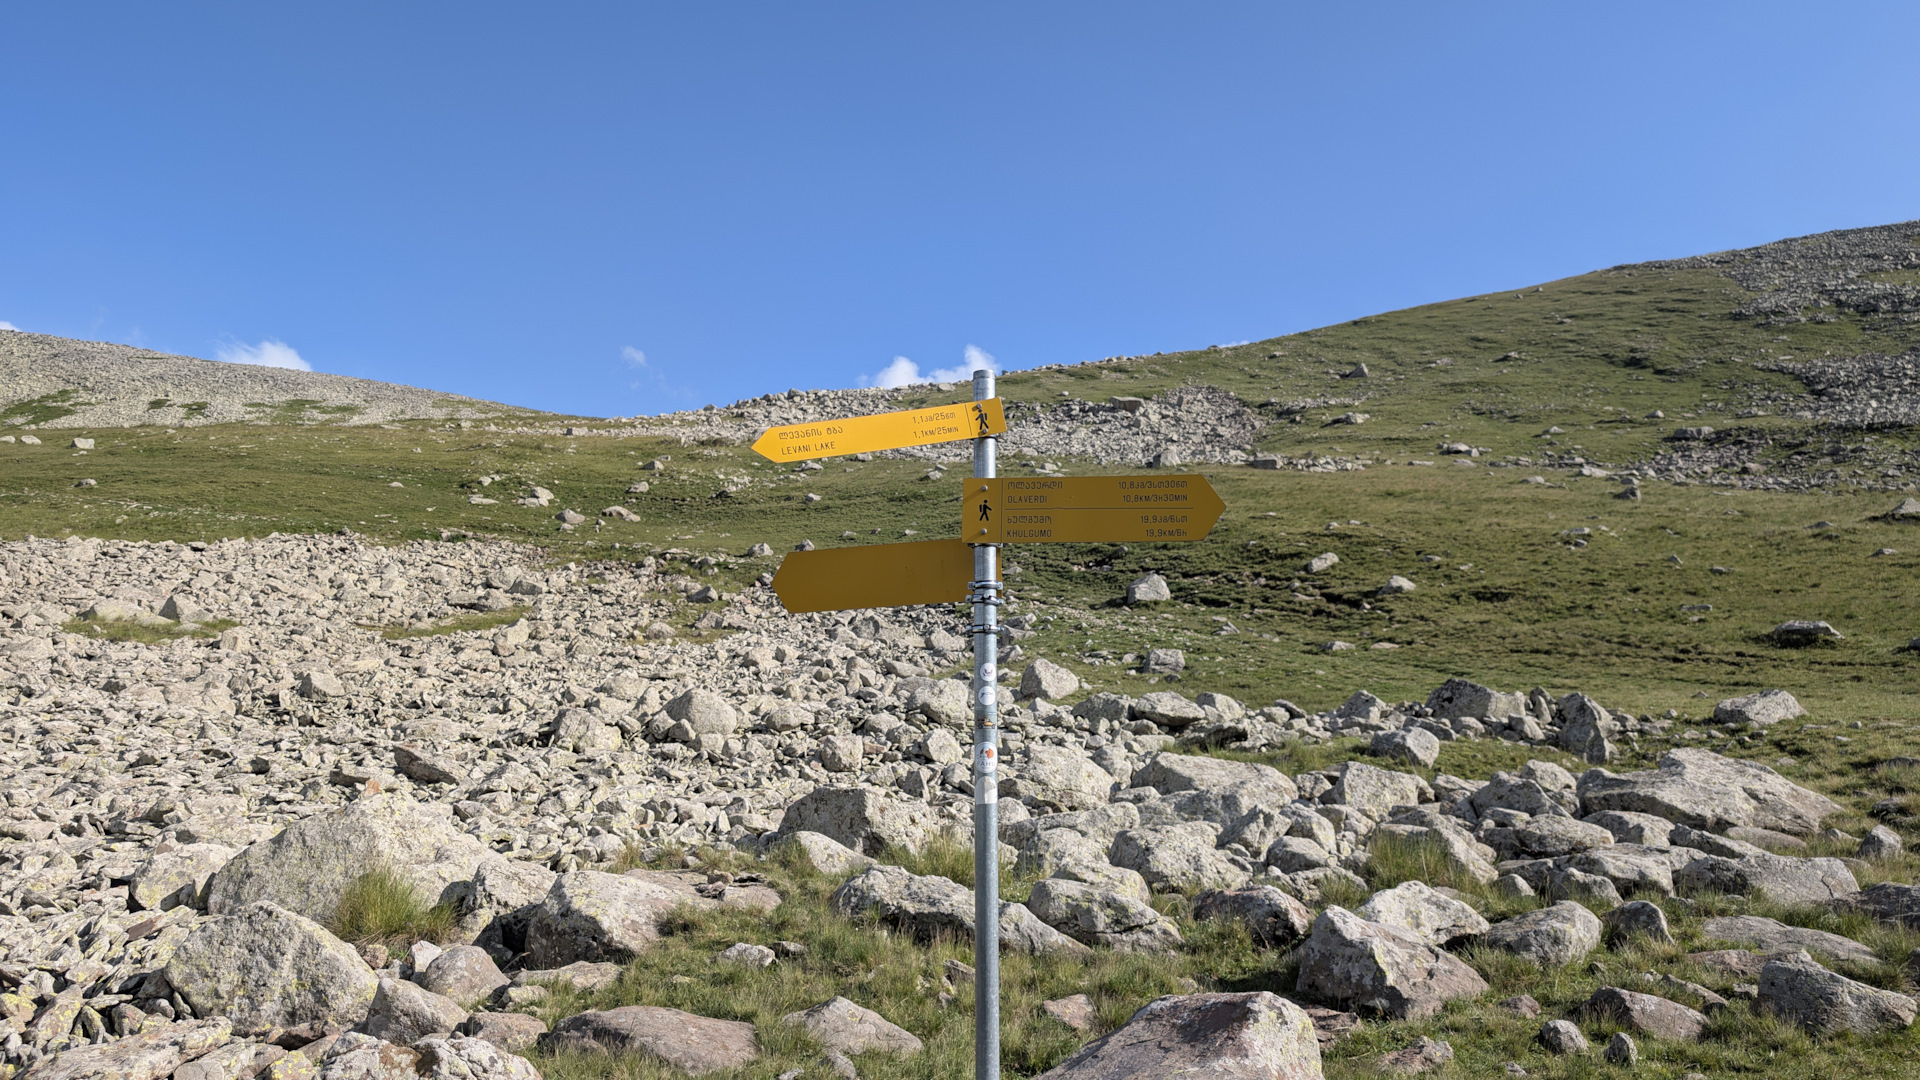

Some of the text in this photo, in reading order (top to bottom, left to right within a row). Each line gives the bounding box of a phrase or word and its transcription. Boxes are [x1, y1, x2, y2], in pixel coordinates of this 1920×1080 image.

[778, 425, 844, 440] ლევანის ტბა
[781, 440, 836, 456] LEVANI LAKE
[1007, 480, 1063, 490] ოლავერდი
[1007, 495, 1048, 504] OLAVERDI
[1006, 529, 1052, 538] KHULGUMO
